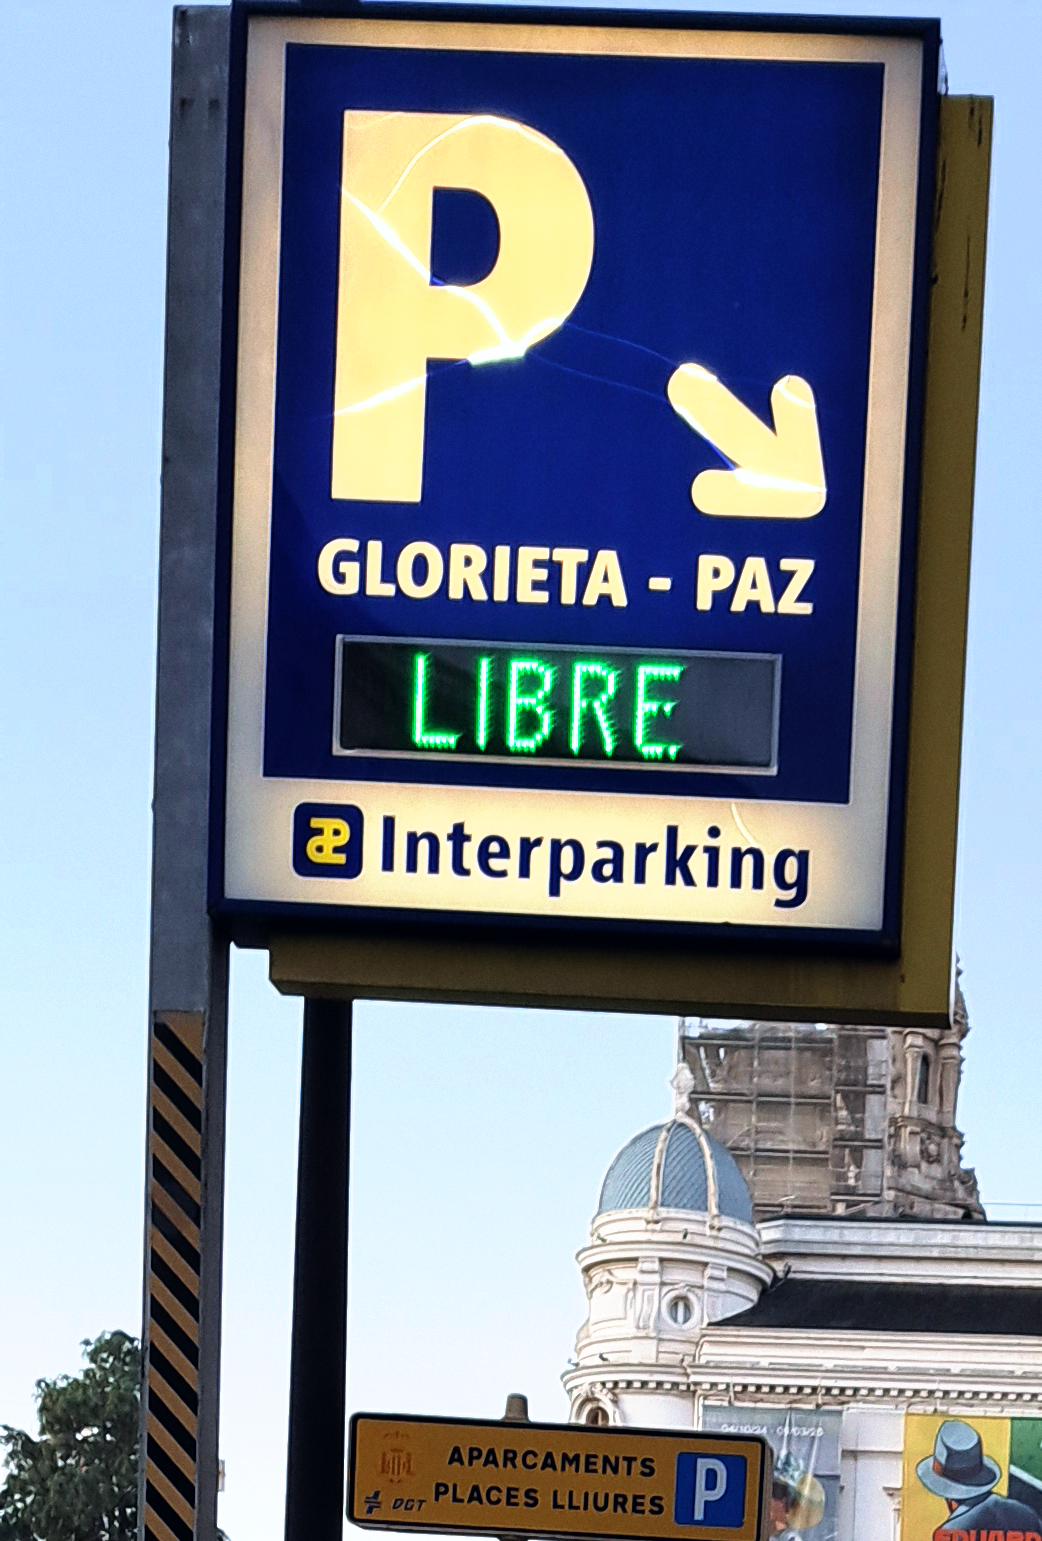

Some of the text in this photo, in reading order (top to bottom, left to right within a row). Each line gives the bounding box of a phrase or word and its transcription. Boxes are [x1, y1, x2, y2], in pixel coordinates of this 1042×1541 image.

[331, 109, 596, 503] P
[317, 537, 816, 617] GLORIETA - PAZ
[411, 652, 687, 761] LIBRE
[380, 814, 811, 909] Interparking
[447, 1445, 657, 1478] APARCAMENTS
[693, 1457, 728, 1522] P
[392, 1498, 426, 1511] DGT
[434, 1482, 665, 1516] PLACES LLIURES
